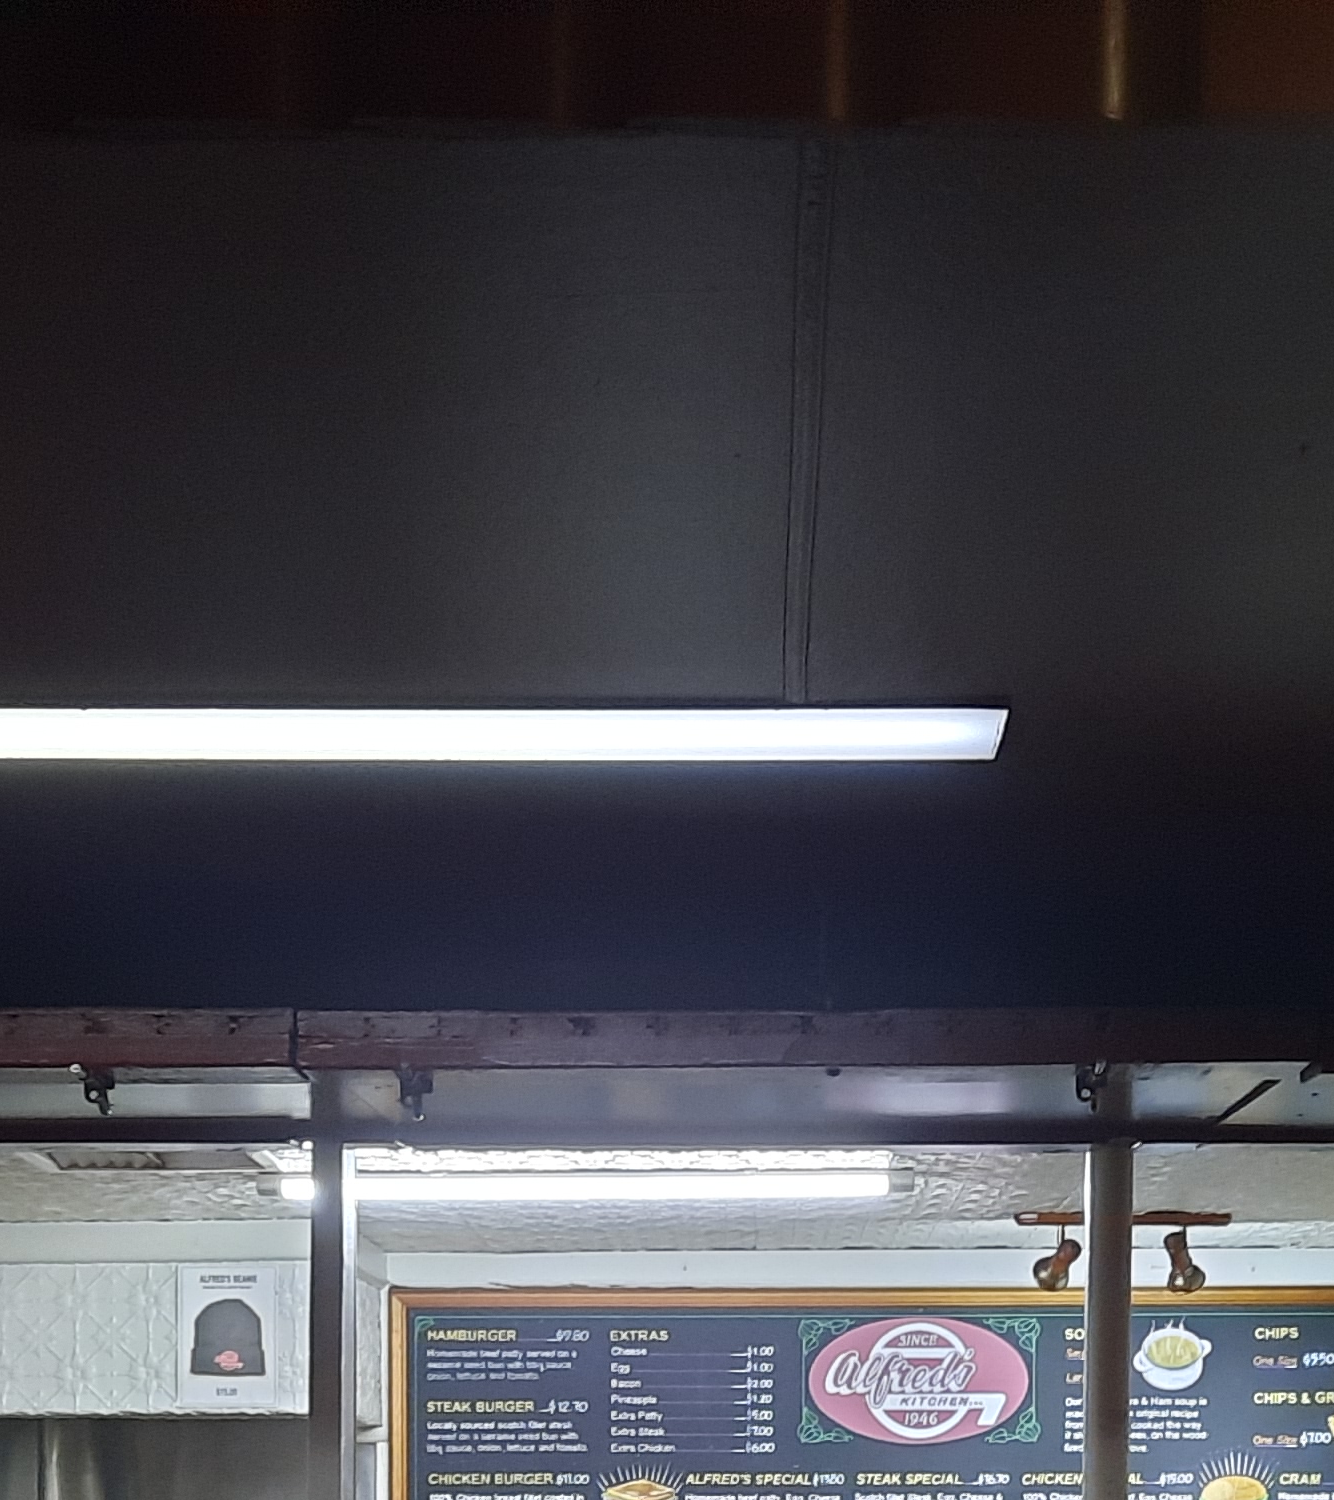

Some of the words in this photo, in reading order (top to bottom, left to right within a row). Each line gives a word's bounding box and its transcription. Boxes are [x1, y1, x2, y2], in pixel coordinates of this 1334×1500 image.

[427, 1330, 516, 1341] HAMBURGER
[610, 1330, 669, 1341] EXTRAS
[1255, 1327, 1299, 1339] CHIPS
[898, 1335, 938, 1346] SINCE
[610, 1347, 647, 1356] Cheese
[610, 1363, 630, 1374] Egg
[825, 1349, 976, 1409] Alfred's
[610, 1395, 657, 1406] Pineapple
[899, 1396, 969, 1407] KITCHEN
[1254, 1392, 1297, 1404] CHIPS
[1301, 1392, 1311, 1403] &
[427, 1401, 471, 1413] STEAK
[476, 1401, 535, 1412] BURGER
[610, 1411, 636, 1420] Extra
[904, 1412, 938, 1425] 1946
[610, 1427, 636, 1437] Extra
[638, 1427, 666, 1437] Steak
[610, 1443, 636, 1453] Extra
[638, 1443, 676, 1453] Chicken
[428, 1473, 491, 1484] CHICKEN
[494, 1473, 553, 1484] BURGER
[686, 1474, 751, 1486] ALFRED'S
[755, 1474, 811, 1486] SPECIAL
[856, 1474, 901, 1485] STEAK
[905, 1474, 961, 1485] SPECIAL
[1022, 1474, 1084, 1485] CHICKEN
[1279, 1473, 1321, 1485] CRAM
